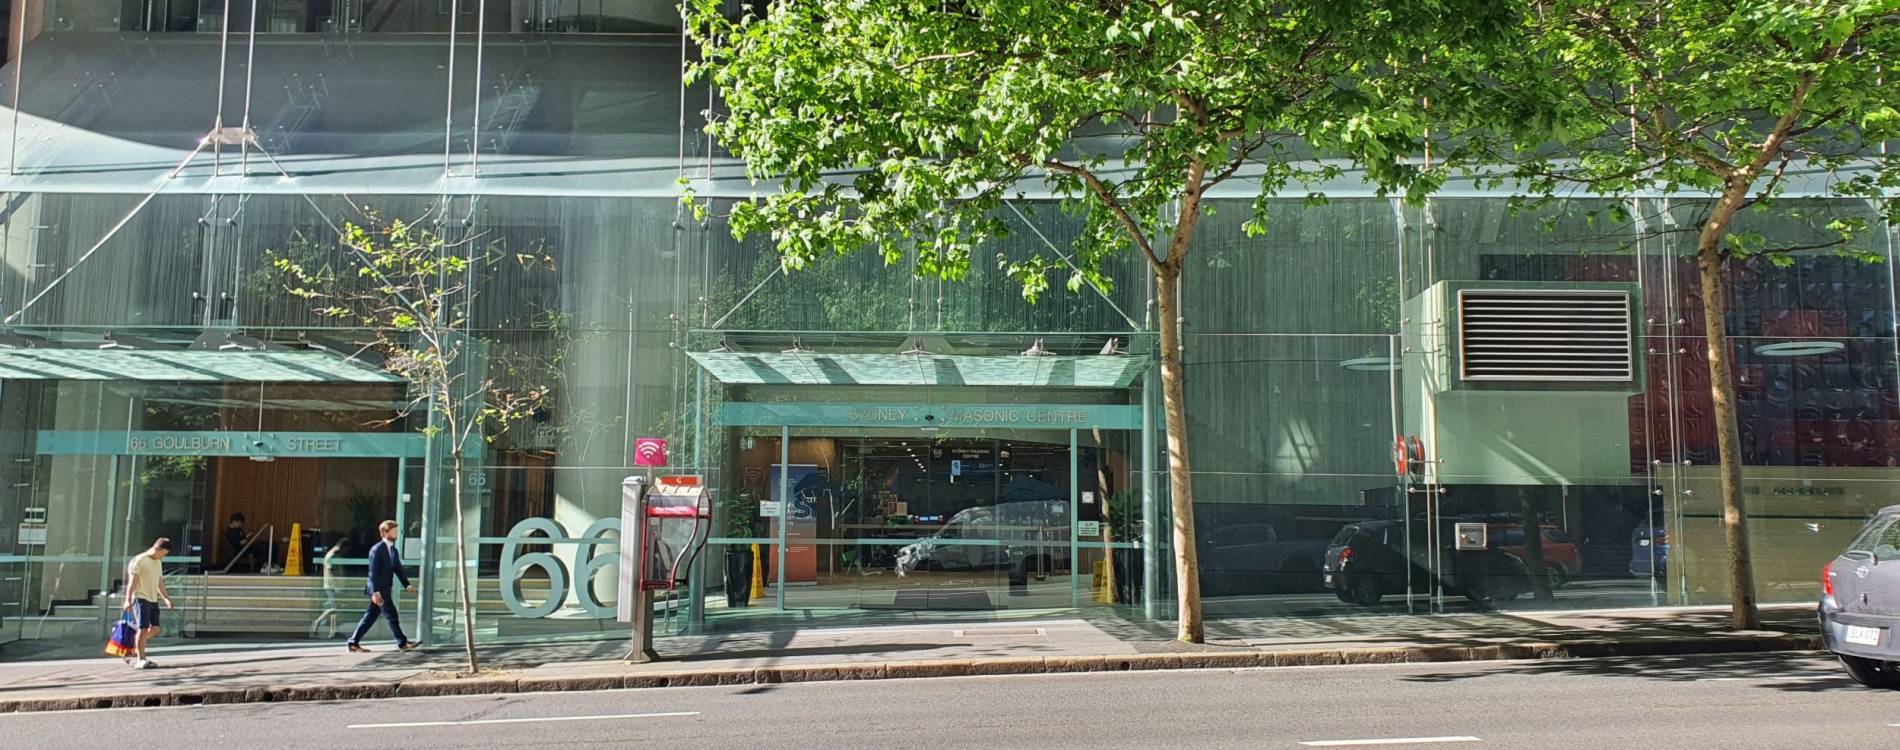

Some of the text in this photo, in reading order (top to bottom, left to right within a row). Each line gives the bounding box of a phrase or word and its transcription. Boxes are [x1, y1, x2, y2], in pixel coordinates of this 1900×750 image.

[848, 408, 1088, 423] SYDNEY MASONIC CENTRE
[130, 436, 344, 451] 66 GOULBURN STREET
[468, 472, 486, 486] 66
[499, 517, 622, 618] 66
